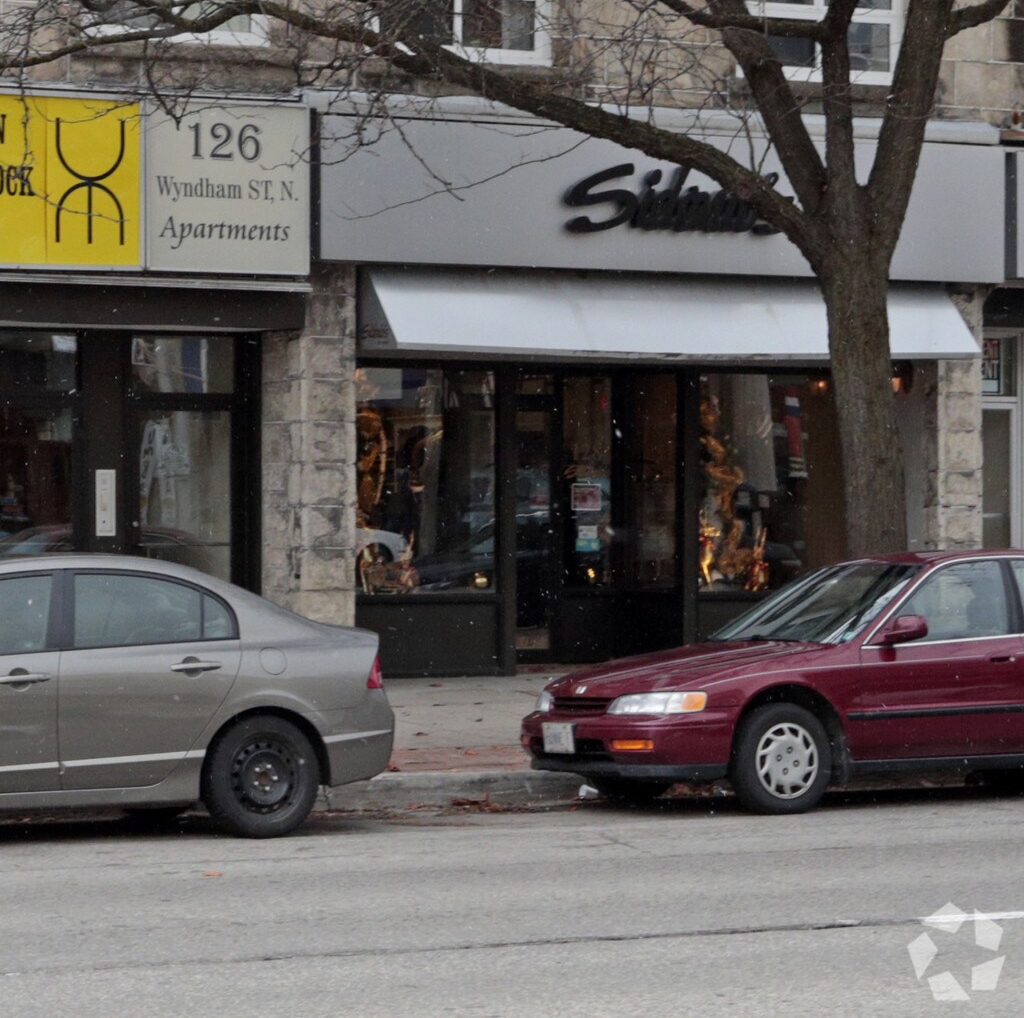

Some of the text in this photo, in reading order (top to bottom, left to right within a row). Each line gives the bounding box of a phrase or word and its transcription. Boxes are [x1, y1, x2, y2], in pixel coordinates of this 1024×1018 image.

[187, 121, 262, 162] 126
[156, 175, 243, 203] Wyndham
[280, 180, 300, 202] N.
[160, 215, 292, 249] Apartments
